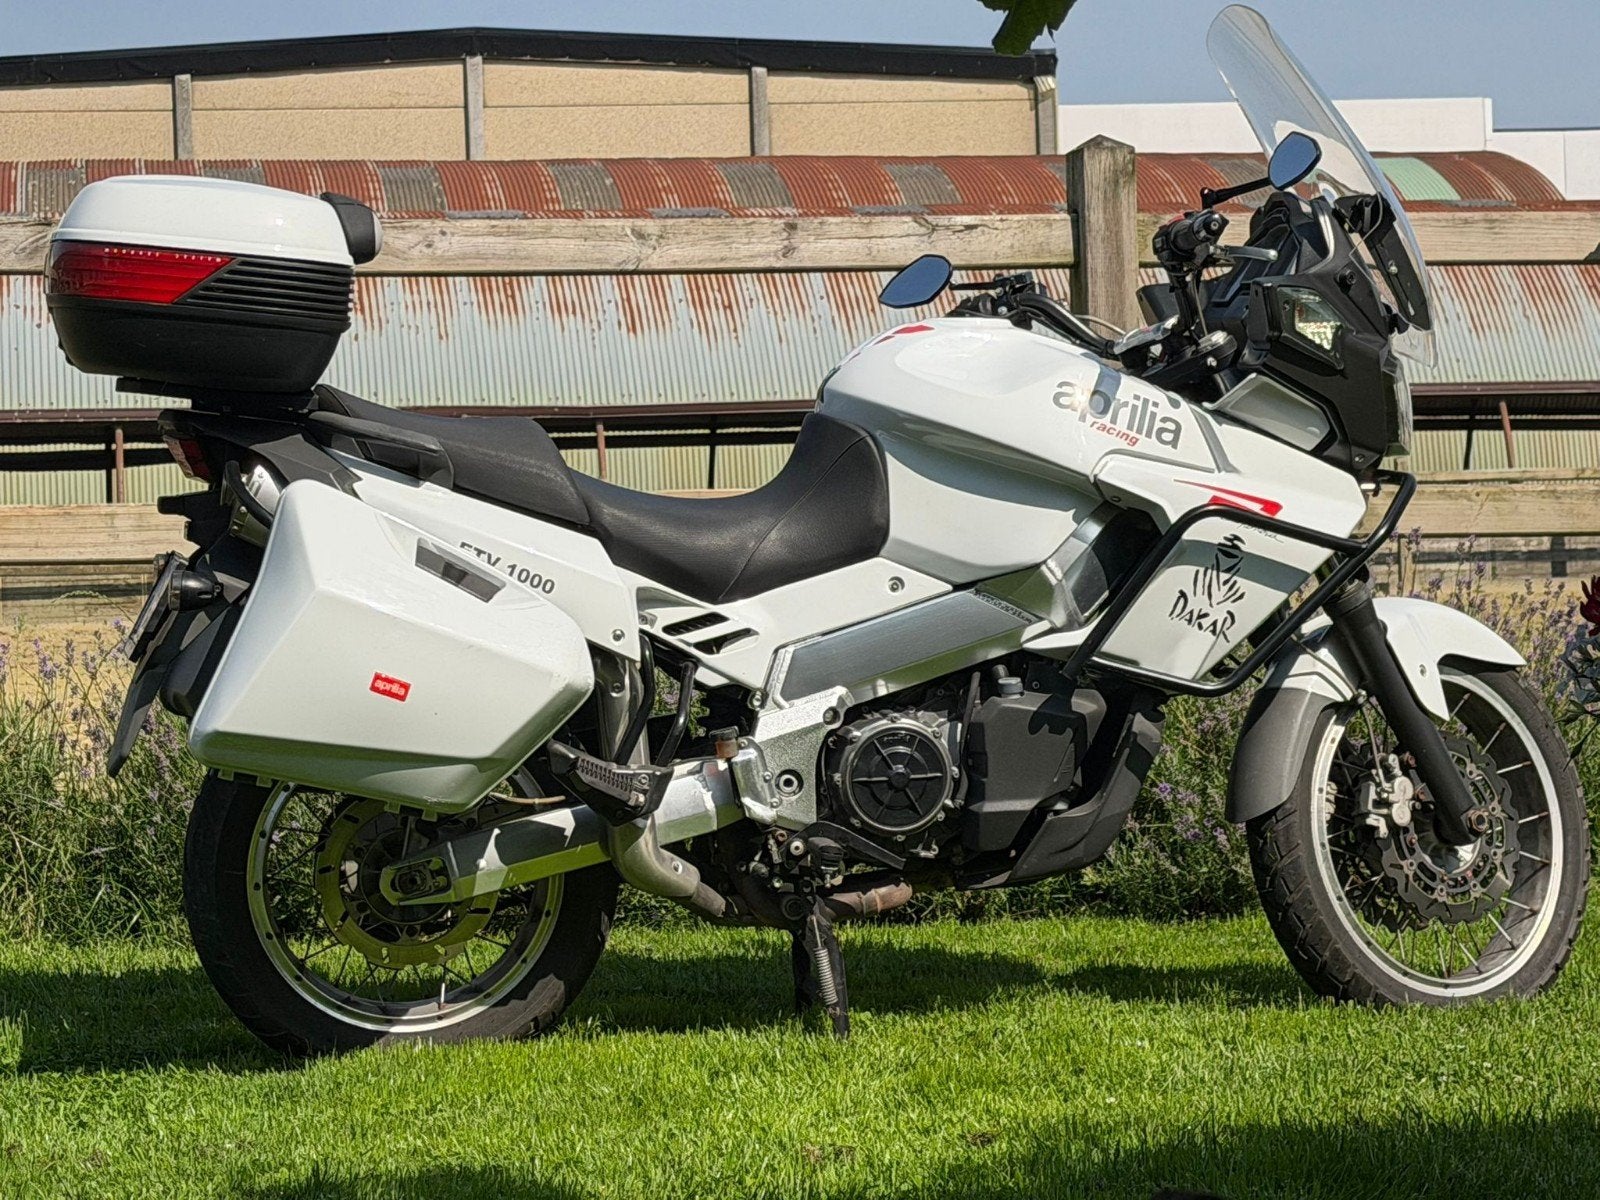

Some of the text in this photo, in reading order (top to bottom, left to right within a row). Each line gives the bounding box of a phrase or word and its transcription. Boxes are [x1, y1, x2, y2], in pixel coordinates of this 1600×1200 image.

[1052, 381, 1182, 450] aprilia
[1090, 420, 1140, 447] racing
[507, 563, 555, 595] 1000
[1168, 589, 1236, 643] DAKAR
[374, 679, 406, 696] aprilia
